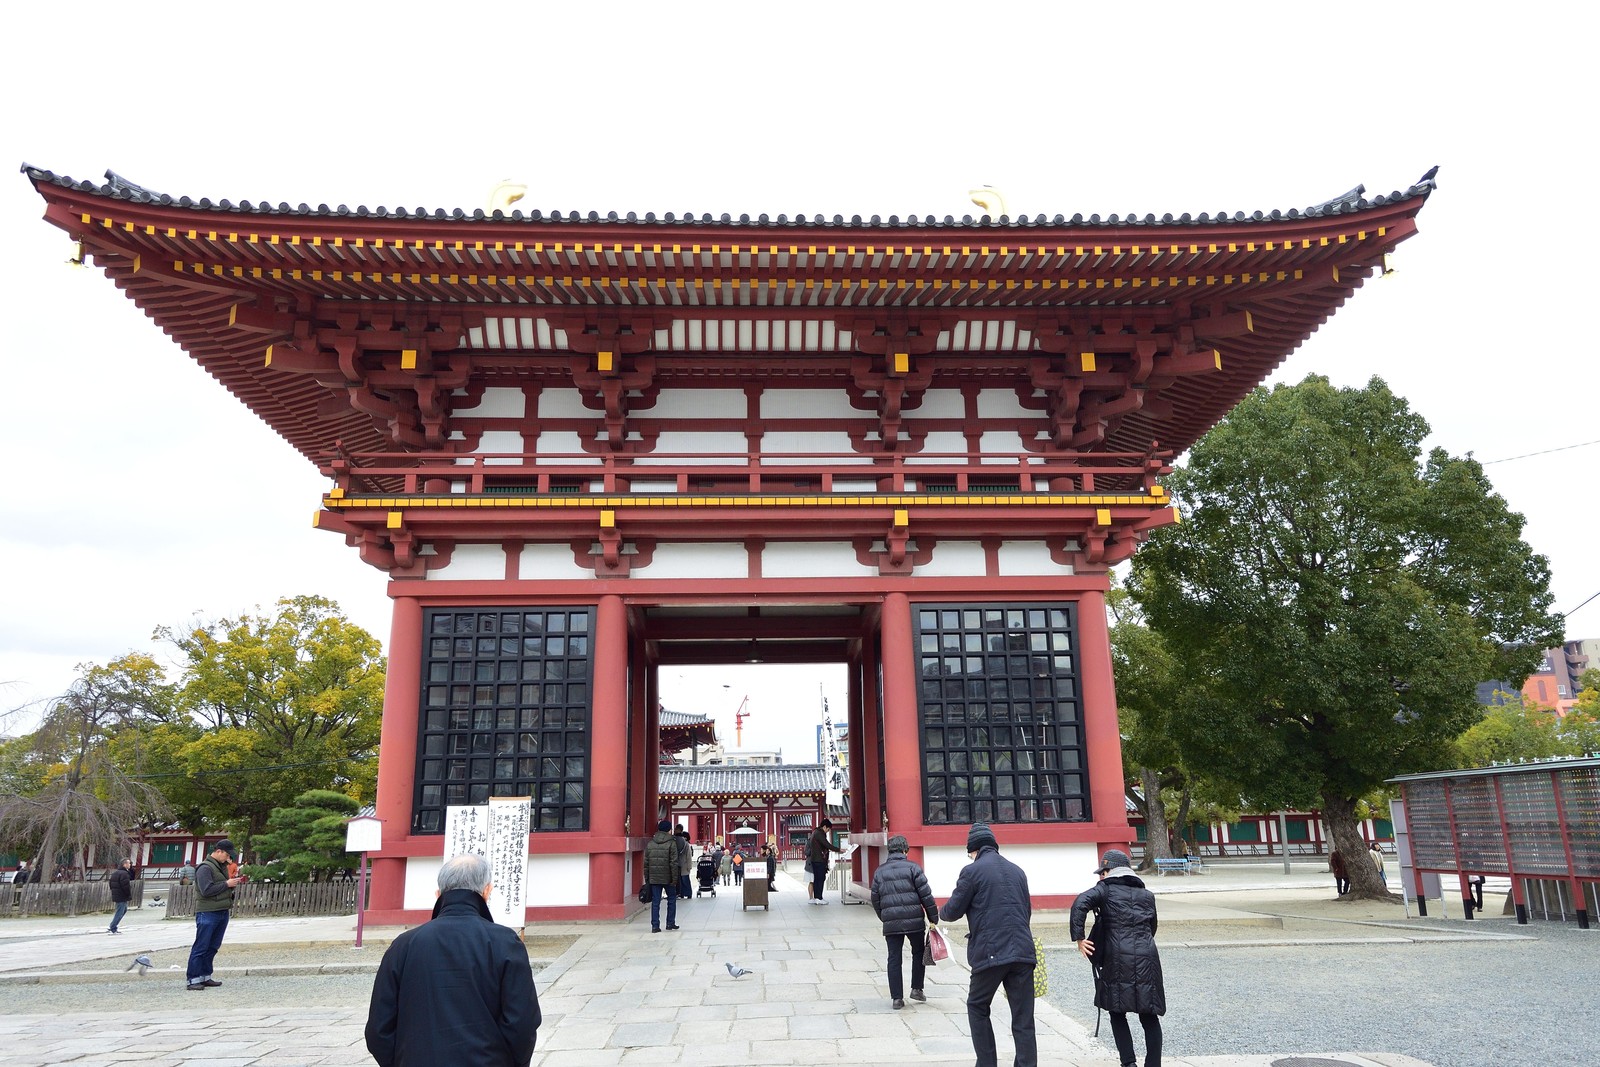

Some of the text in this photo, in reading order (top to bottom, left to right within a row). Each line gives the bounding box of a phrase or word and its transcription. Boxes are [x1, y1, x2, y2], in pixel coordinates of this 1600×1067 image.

[467, 807, 478, 854] 本日どやど
[477, 831, 487, 857] お知
